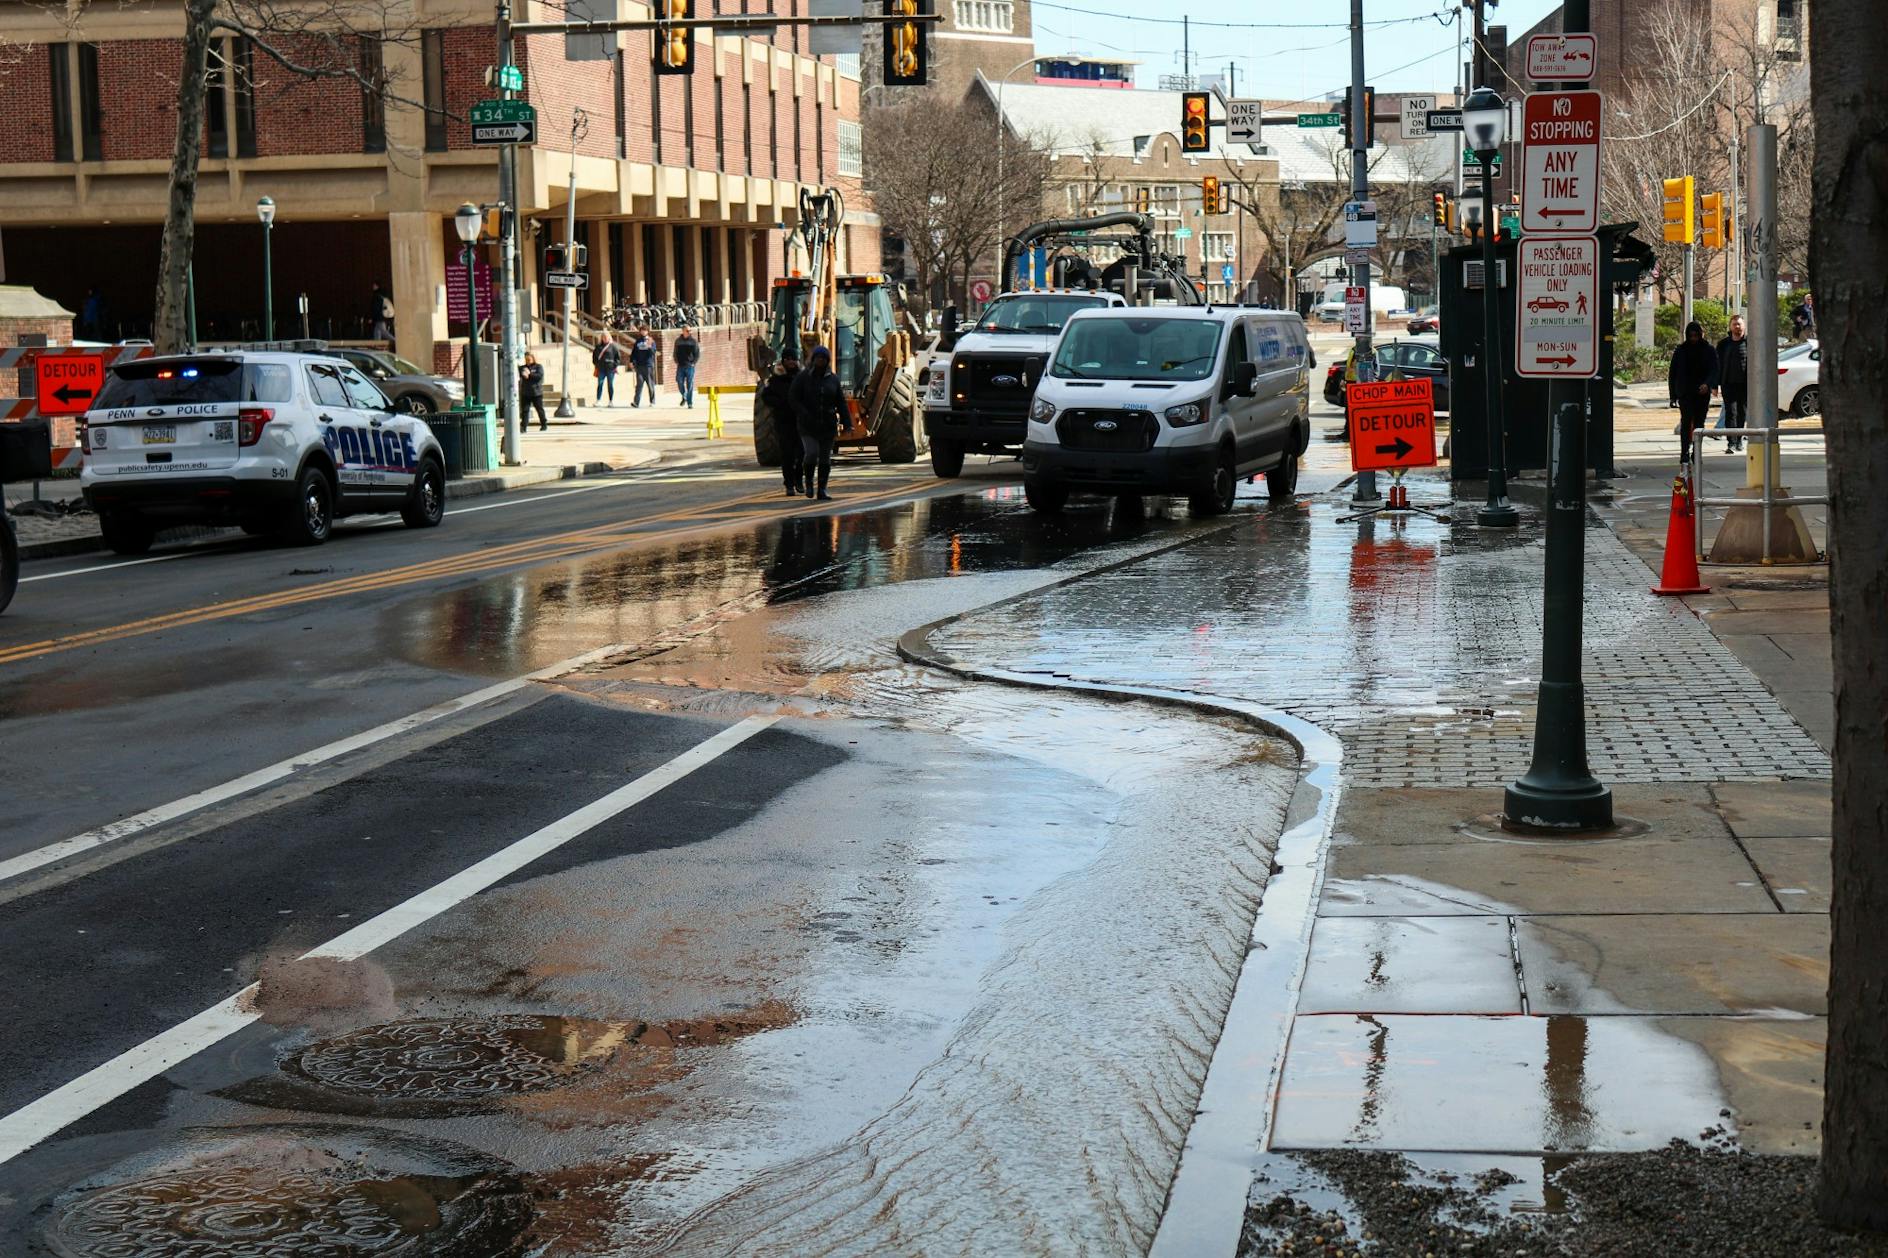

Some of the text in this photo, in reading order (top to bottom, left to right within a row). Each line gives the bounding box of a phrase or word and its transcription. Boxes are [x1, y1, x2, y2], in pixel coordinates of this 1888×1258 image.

[1532, 43, 1545, 52] TOW
[1540, 54, 1556, 62] ZONE
[1231, 104, 1256, 115] ONE
[1410, 99, 1427, 110] NO
[1553, 98, 1572, 116] NO
[518, 111, 531, 121] ST
[1231, 116, 1256, 126] WAY
[1300, 115, 1339, 126] 34th St
[1433, 116, 1451, 125] ONE
[1412, 119, 1424, 127] ON
[478, 128, 515, 138] ONE WAY
[1530, 120, 1594, 139] STOPPING
[1544, 151, 1578, 173] ANY
[1542, 177, 1579, 199] TIME
[1533, 247, 1583, 261] PASSENGER
[1524, 262, 1593, 277] VEHICLE LOADING
[1546, 279, 1569, 292] ONLY
[1530, 316, 1585, 326] 20 MINUTE LIMIT
[1537, 342, 1577, 352] MON-SUN
[43, 363, 97, 378] DETOUR
[1353, 383, 1426, 401] CHOP MAIN
[107, 409, 135, 420] PENN
[177, 404, 218, 415] POLICE
[1360, 412, 1426, 432] DETOUR
[323, 425, 418, 469] POLICE
[118, 461, 208, 473] publicsafety.upenn.edu
[272, 467, 288, 478] S-01
